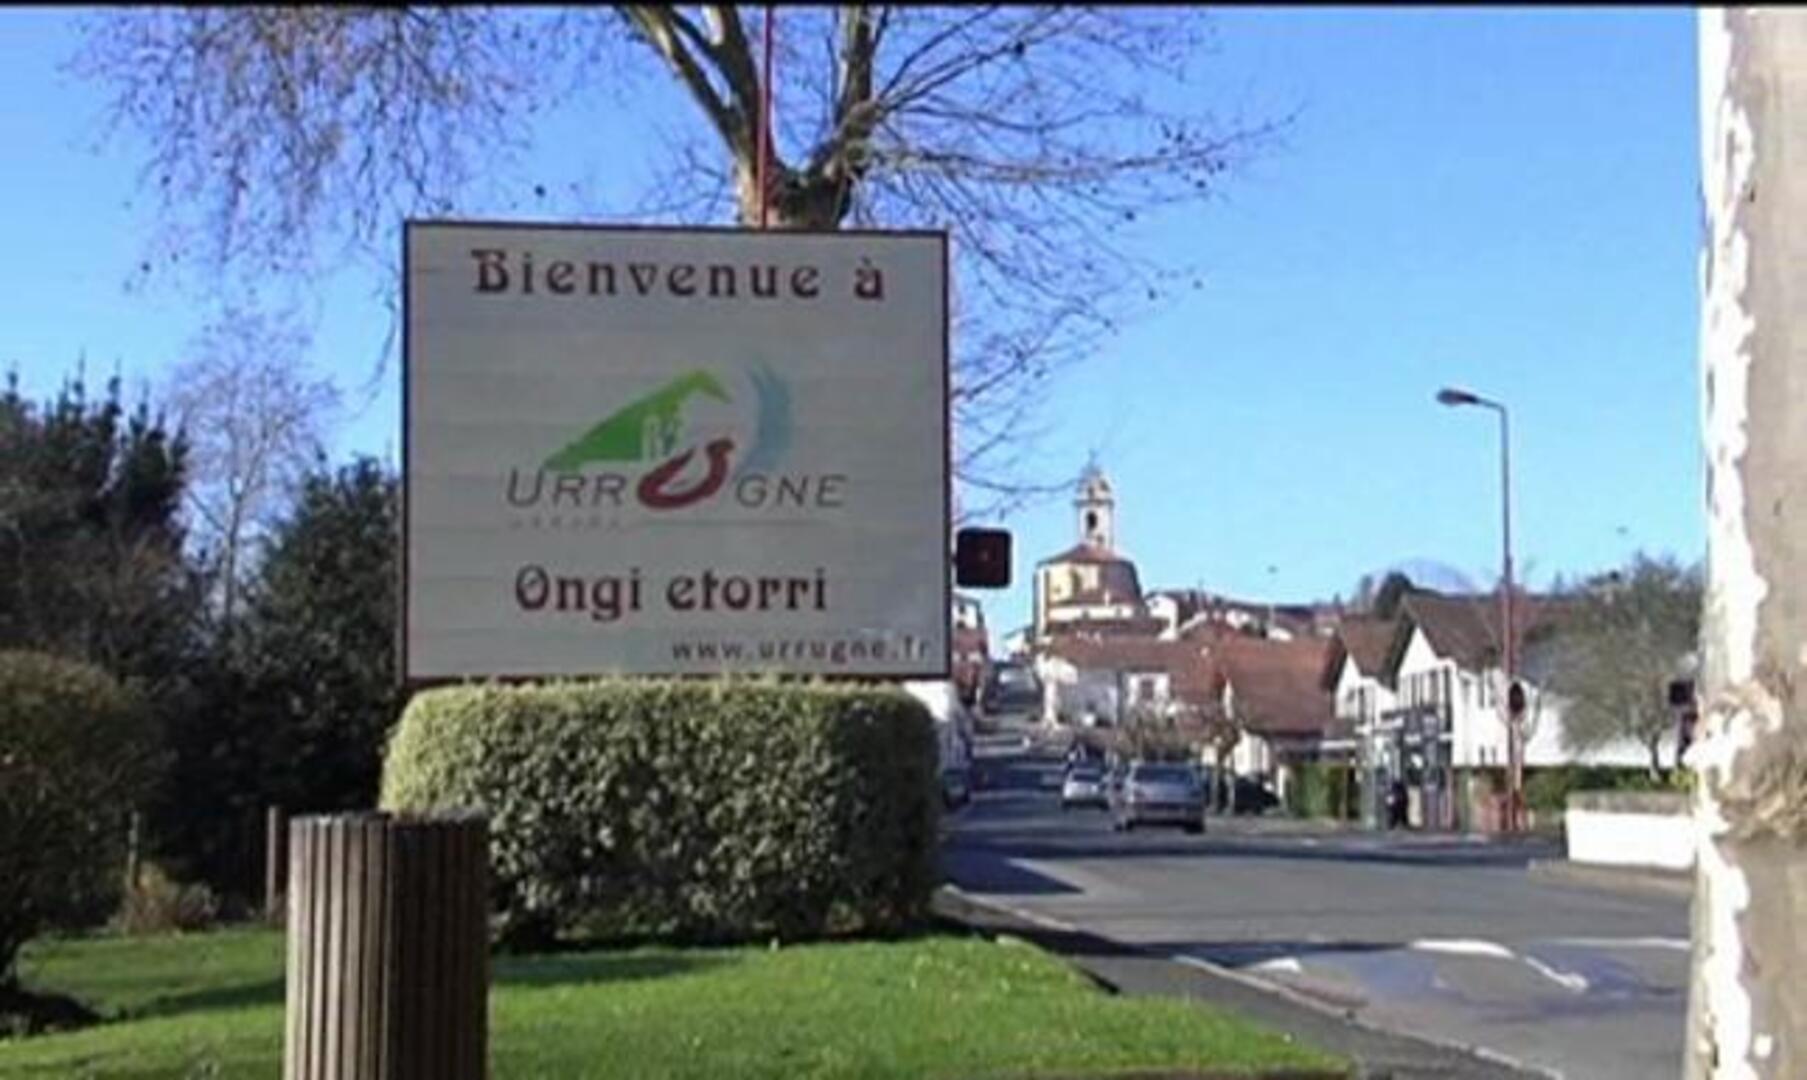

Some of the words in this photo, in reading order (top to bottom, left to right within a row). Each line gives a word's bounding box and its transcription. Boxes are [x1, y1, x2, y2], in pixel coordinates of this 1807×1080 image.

[471, 249, 820, 300] Bienvenue
[854, 256, 885, 301] à
[515, 564, 642, 621] Ongi
[666, 568, 828, 611] etorri
[671, 635, 931, 665] www.urrugne.fr
